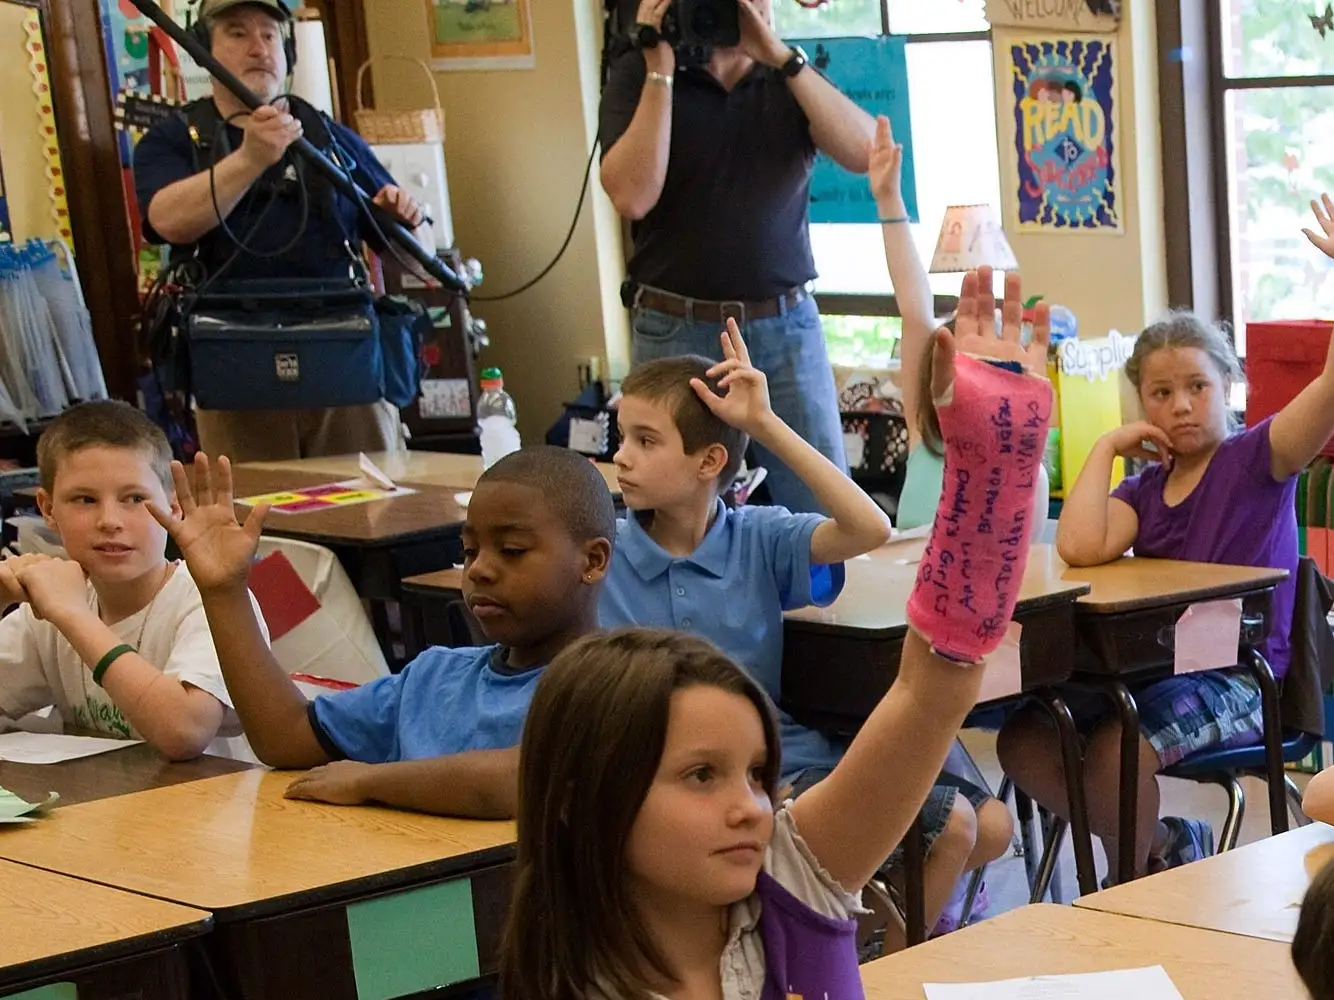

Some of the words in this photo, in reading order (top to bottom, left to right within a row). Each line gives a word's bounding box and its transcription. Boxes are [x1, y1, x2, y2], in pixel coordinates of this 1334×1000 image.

[1004, 0, 1084, 24] WELCOM
[1019, 97, 1106, 152] READ
[1064, 334, 1130, 379] Suppli
